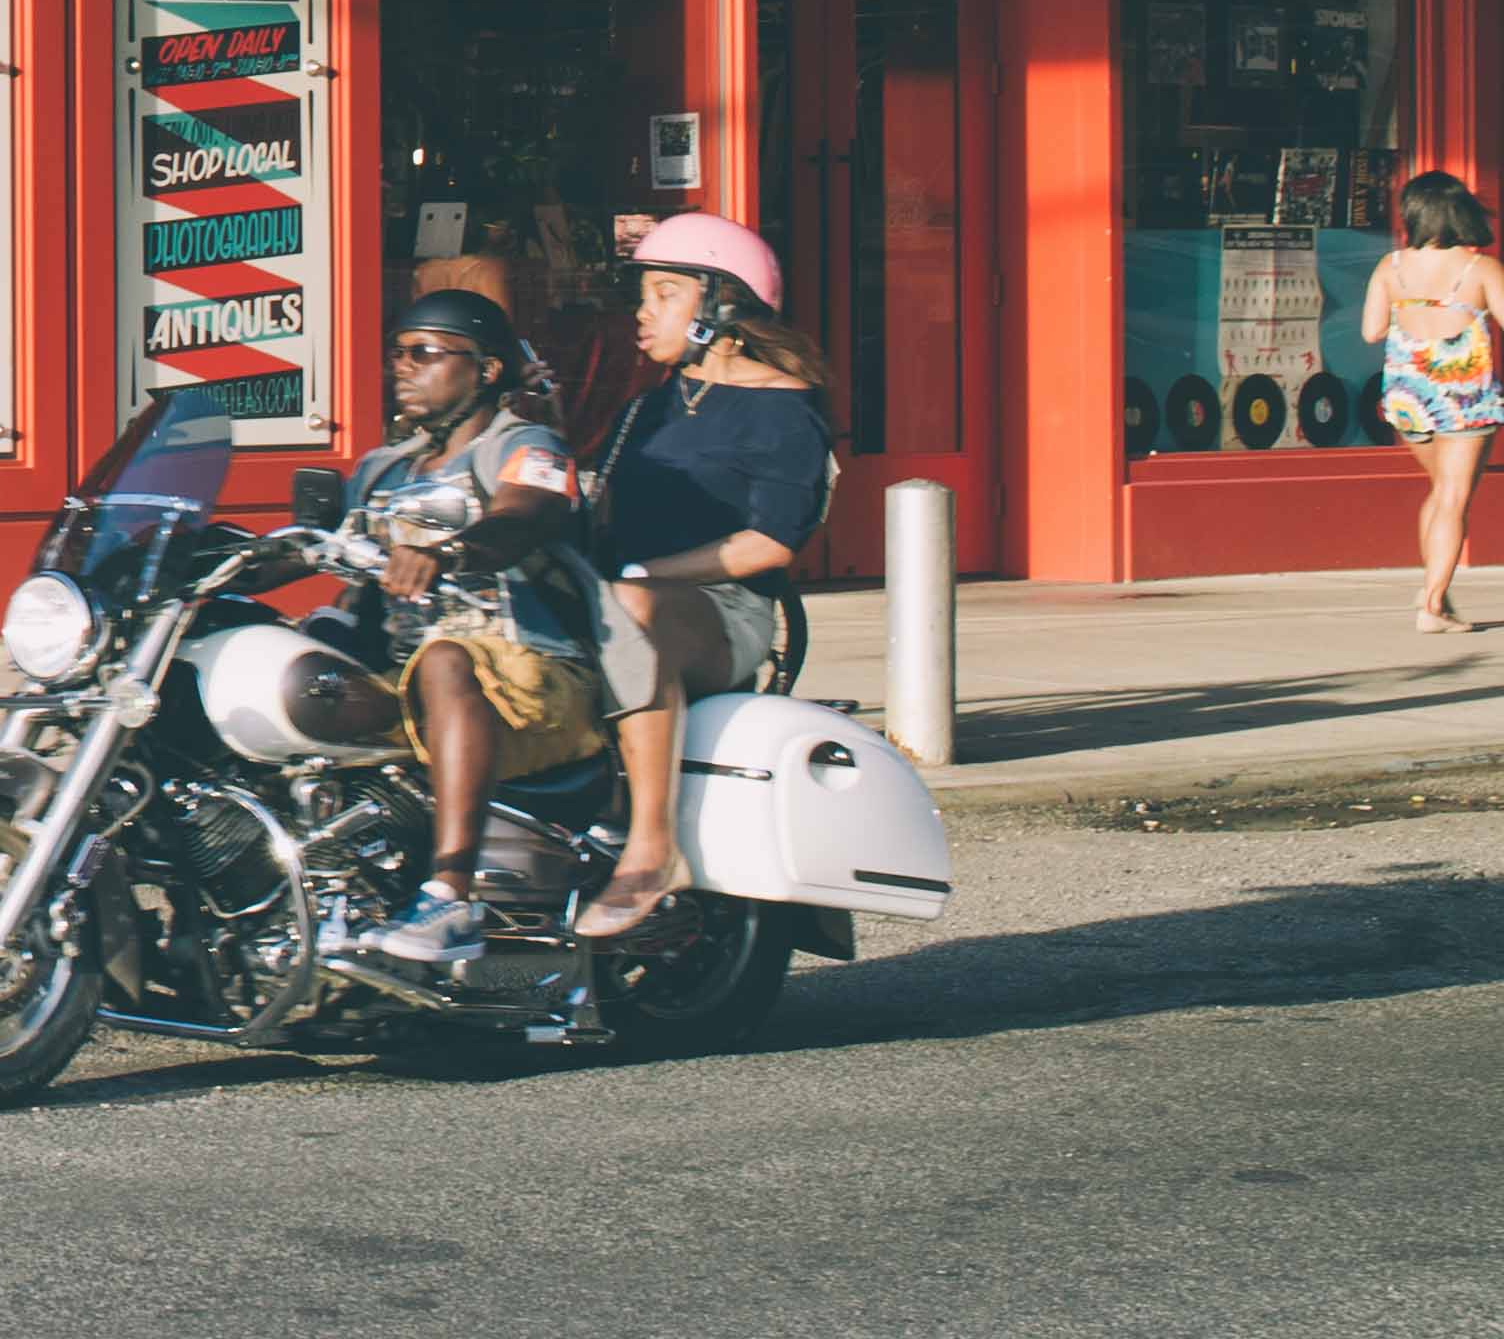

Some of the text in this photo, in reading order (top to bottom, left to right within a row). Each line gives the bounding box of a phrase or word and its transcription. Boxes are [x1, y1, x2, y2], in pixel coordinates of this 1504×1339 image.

[159, 26, 286, 65] OPEN DAILY
[150, 139, 297, 189] SHOP LOCAL
[149, 206, 300, 268] PHOTOGRAPHY
[147, 294, 302, 352] ANTIQUES
